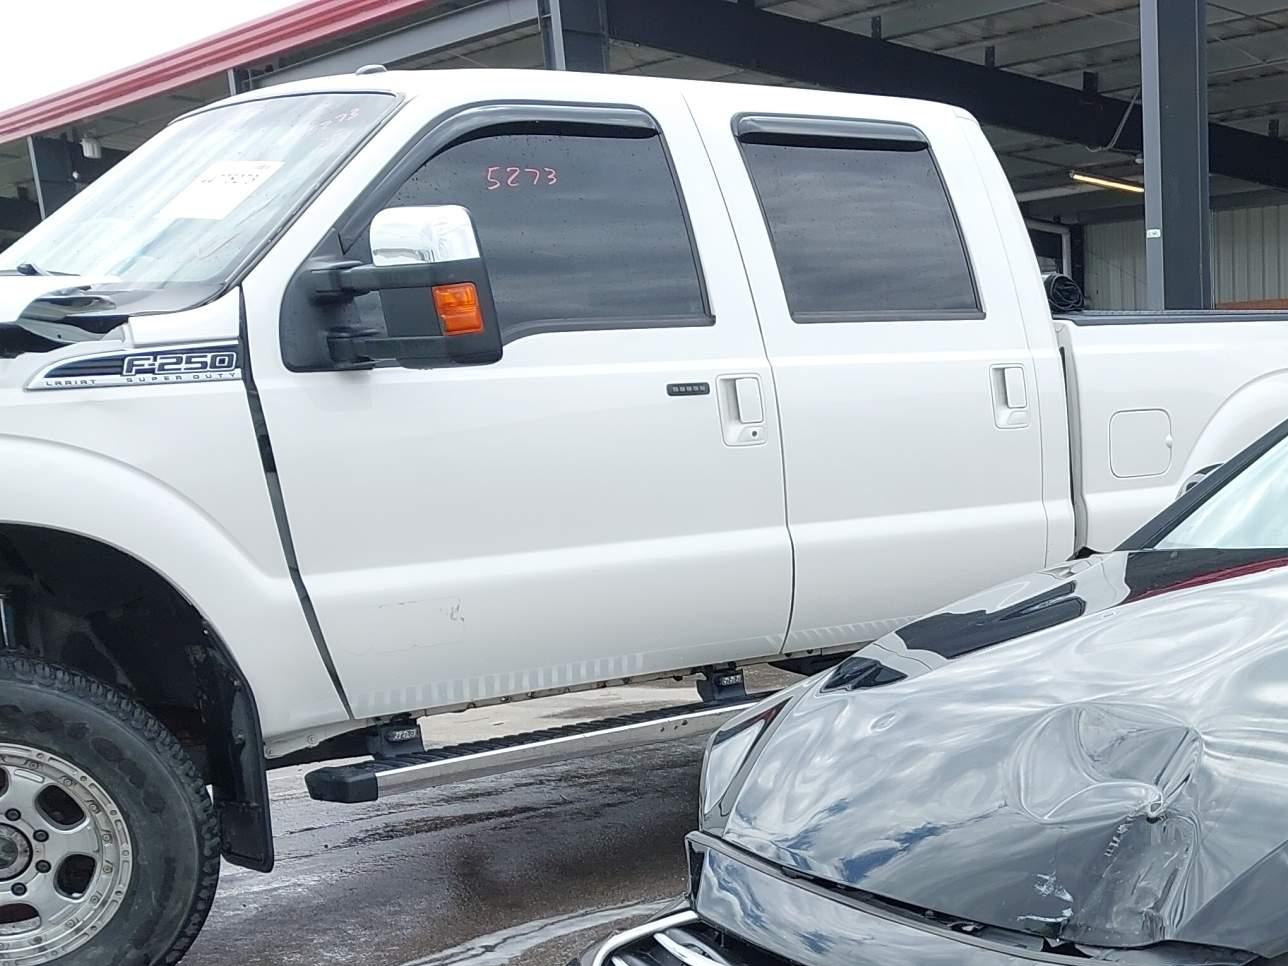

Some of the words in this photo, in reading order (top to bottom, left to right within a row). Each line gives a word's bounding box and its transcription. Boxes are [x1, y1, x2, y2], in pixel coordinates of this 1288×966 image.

[487, 166, 557, 190] 5273
[122, 352, 237, 376] F-250
[45, 379, 97, 387] LARIAT
[126, 375, 183, 383] SUPER
[192, 372, 236, 380] DUTY
